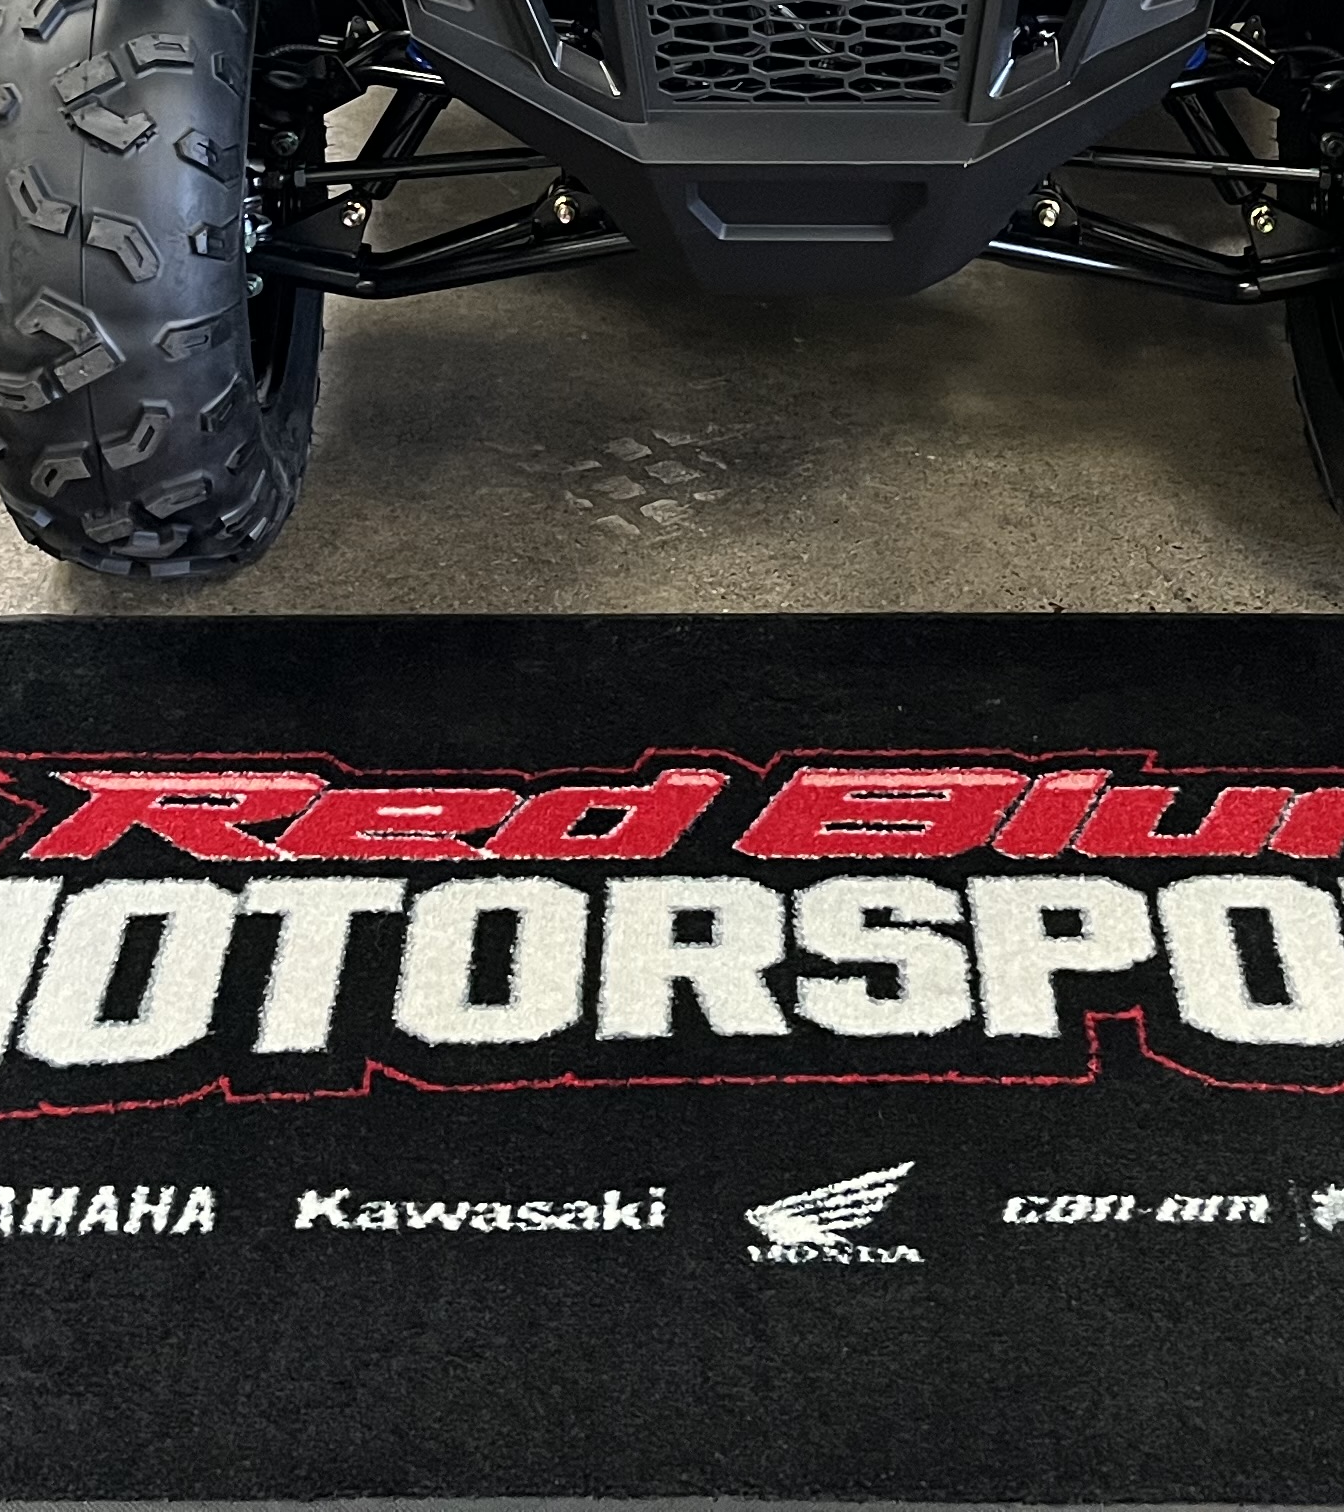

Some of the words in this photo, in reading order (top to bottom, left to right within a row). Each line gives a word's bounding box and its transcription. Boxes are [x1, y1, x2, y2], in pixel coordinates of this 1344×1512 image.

[20, 768, 730, 861] Red
[294, 1186, 667, 1233] Kawasaki
[746, 1244, 926, 1265] HONDA
